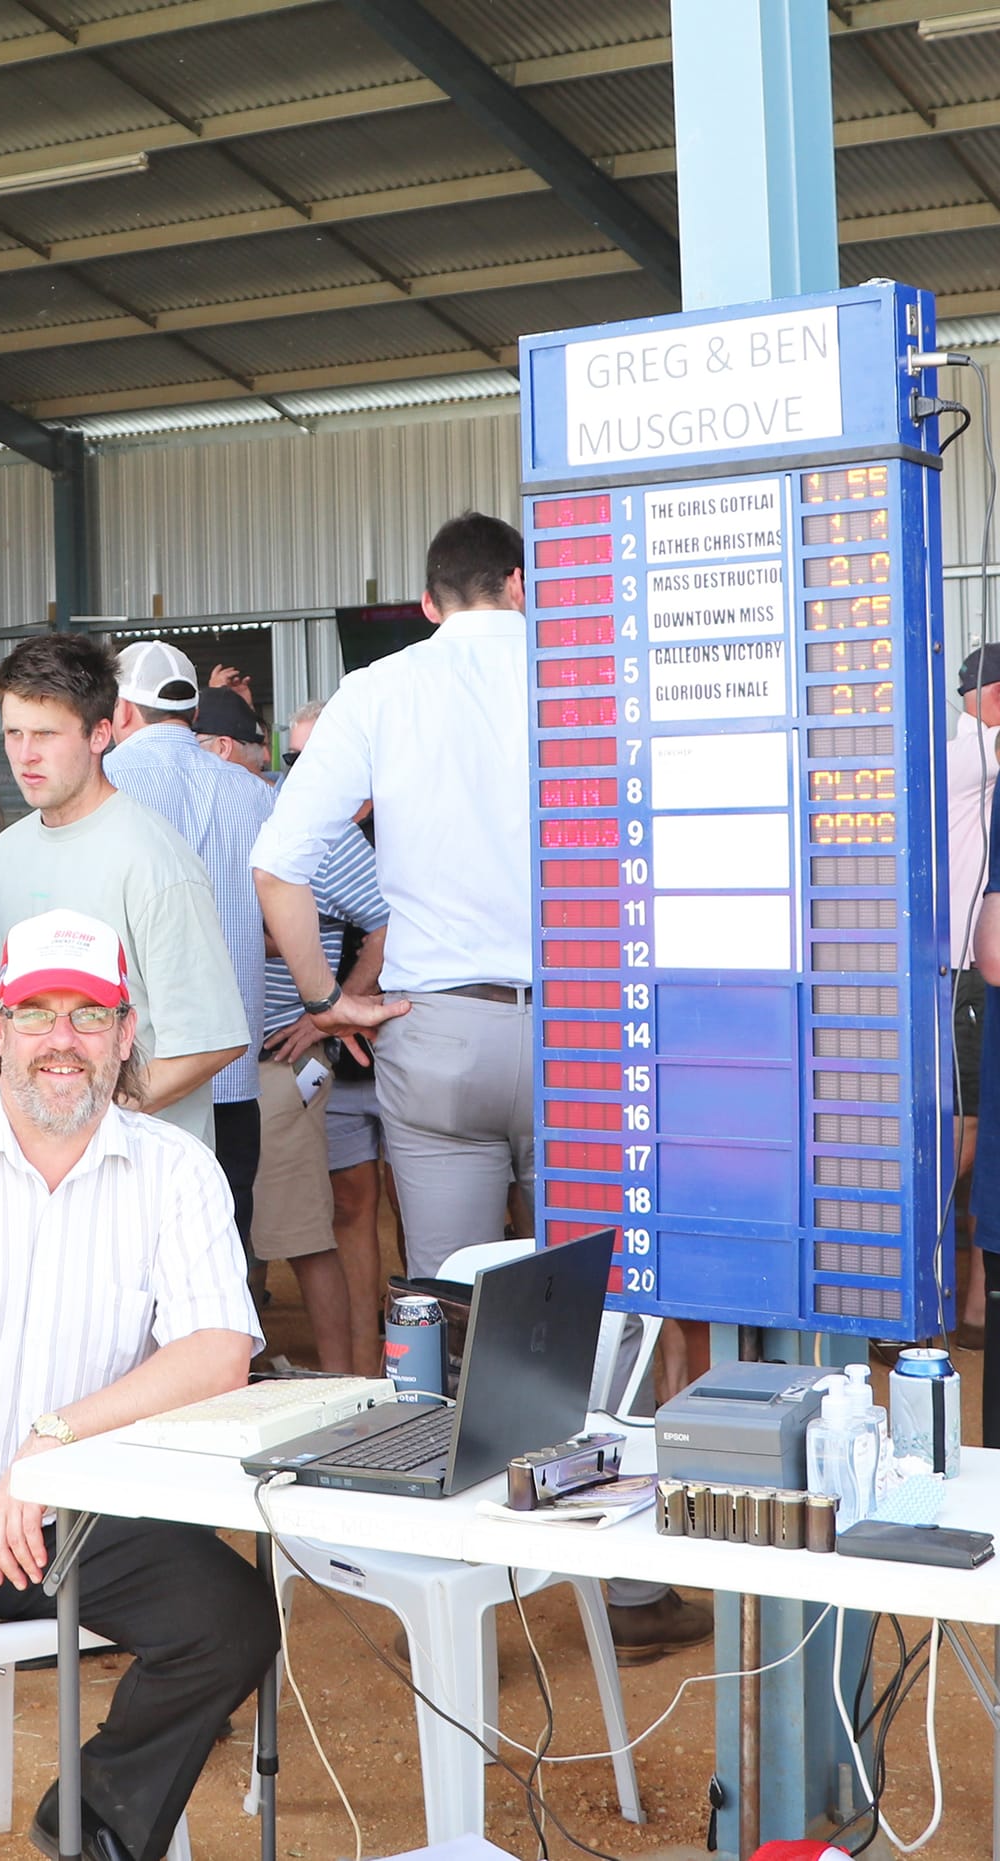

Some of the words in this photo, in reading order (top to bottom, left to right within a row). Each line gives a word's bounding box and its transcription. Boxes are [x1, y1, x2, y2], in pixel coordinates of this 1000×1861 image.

[586, 343, 689, 390] GREG
[705, 335, 735, 374] &
[749, 322, 829, 368] BEN
[577, 395, 805, 457] MUSGROVE
[621, 495, 632, 521] 1
[651, 502, 674, 519] THE
[678, 498, 716, 517] GIRLS
[621, 533, 637, 560] 2
[652, 537, 700, 556] FATHER
[704, 529, 782, 552] CHRISTMAS
[622, 575, 638, 602] 3
[653, 574, 690, 592] MASS
[621, 615, 638, 641] 4
[654, 608, 736, 629] DOWNTOWN
[739, 605, 774, 623] MISS
[655, 645, 720, 665] GALLEONS
[723, 641, 782, 661] VICTORY
[623, 657, 639, 684] 5
[656, 682, 722, 701] GLORIOUS
[726, 681, 769, 698] FINALE
[624, 696, 641, 723] 6
[626, 739, 642, 766] 7
[627, 777, 643, 804] 8
[627, 820, 643, 846] 9
[621, 858, 648, 885] 10
[624, 900, 646, 926] 11
[53, 930, 96, 942] BIRCHIP
[623, 941, 650, 967] 12
[623, 983, 649, 1010] 13
[623, 1022, 651, 1048] 14
[623, 1066, 650, 1092] 15
[623, 1104, 650, 1131] 16
[625, 1145, 651, 1171] 17
[624, 1187, 651, 1213] 18
[624, 1228, 650, 1255] 19
[627, 1268, 655, 1292] 20
[663, 1432, 690, 1442] EPSON
